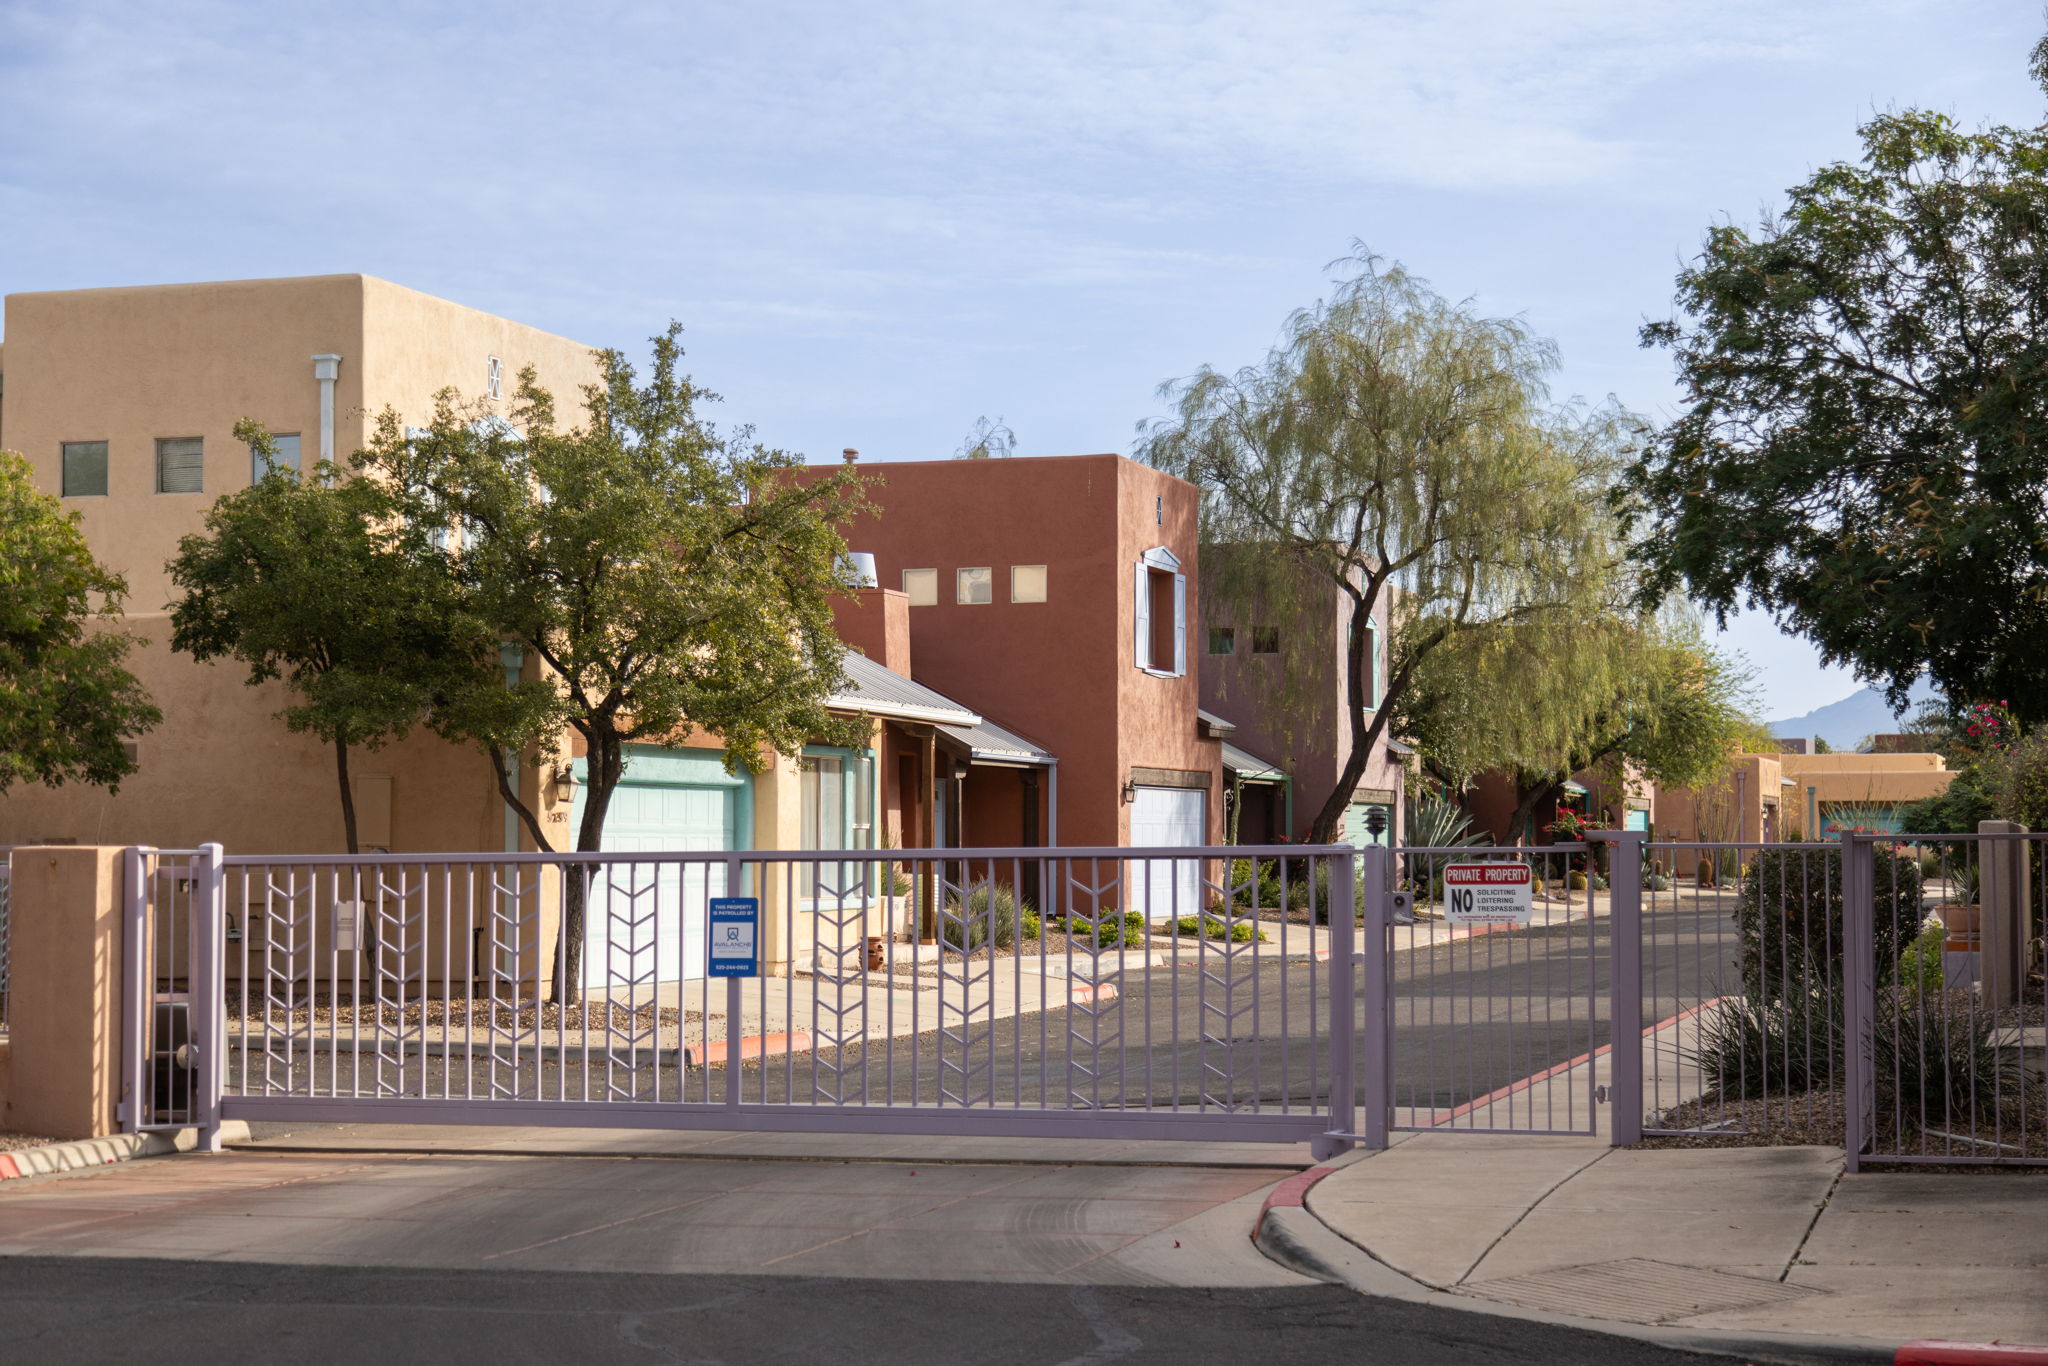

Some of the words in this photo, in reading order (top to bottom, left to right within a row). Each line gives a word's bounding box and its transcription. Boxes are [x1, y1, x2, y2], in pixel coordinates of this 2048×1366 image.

[1447, 869, 1481, 881] PRIVATE
[1485, 868, 1528, 881] PROPERTY
[1451, 888, 1473, 913] NO
